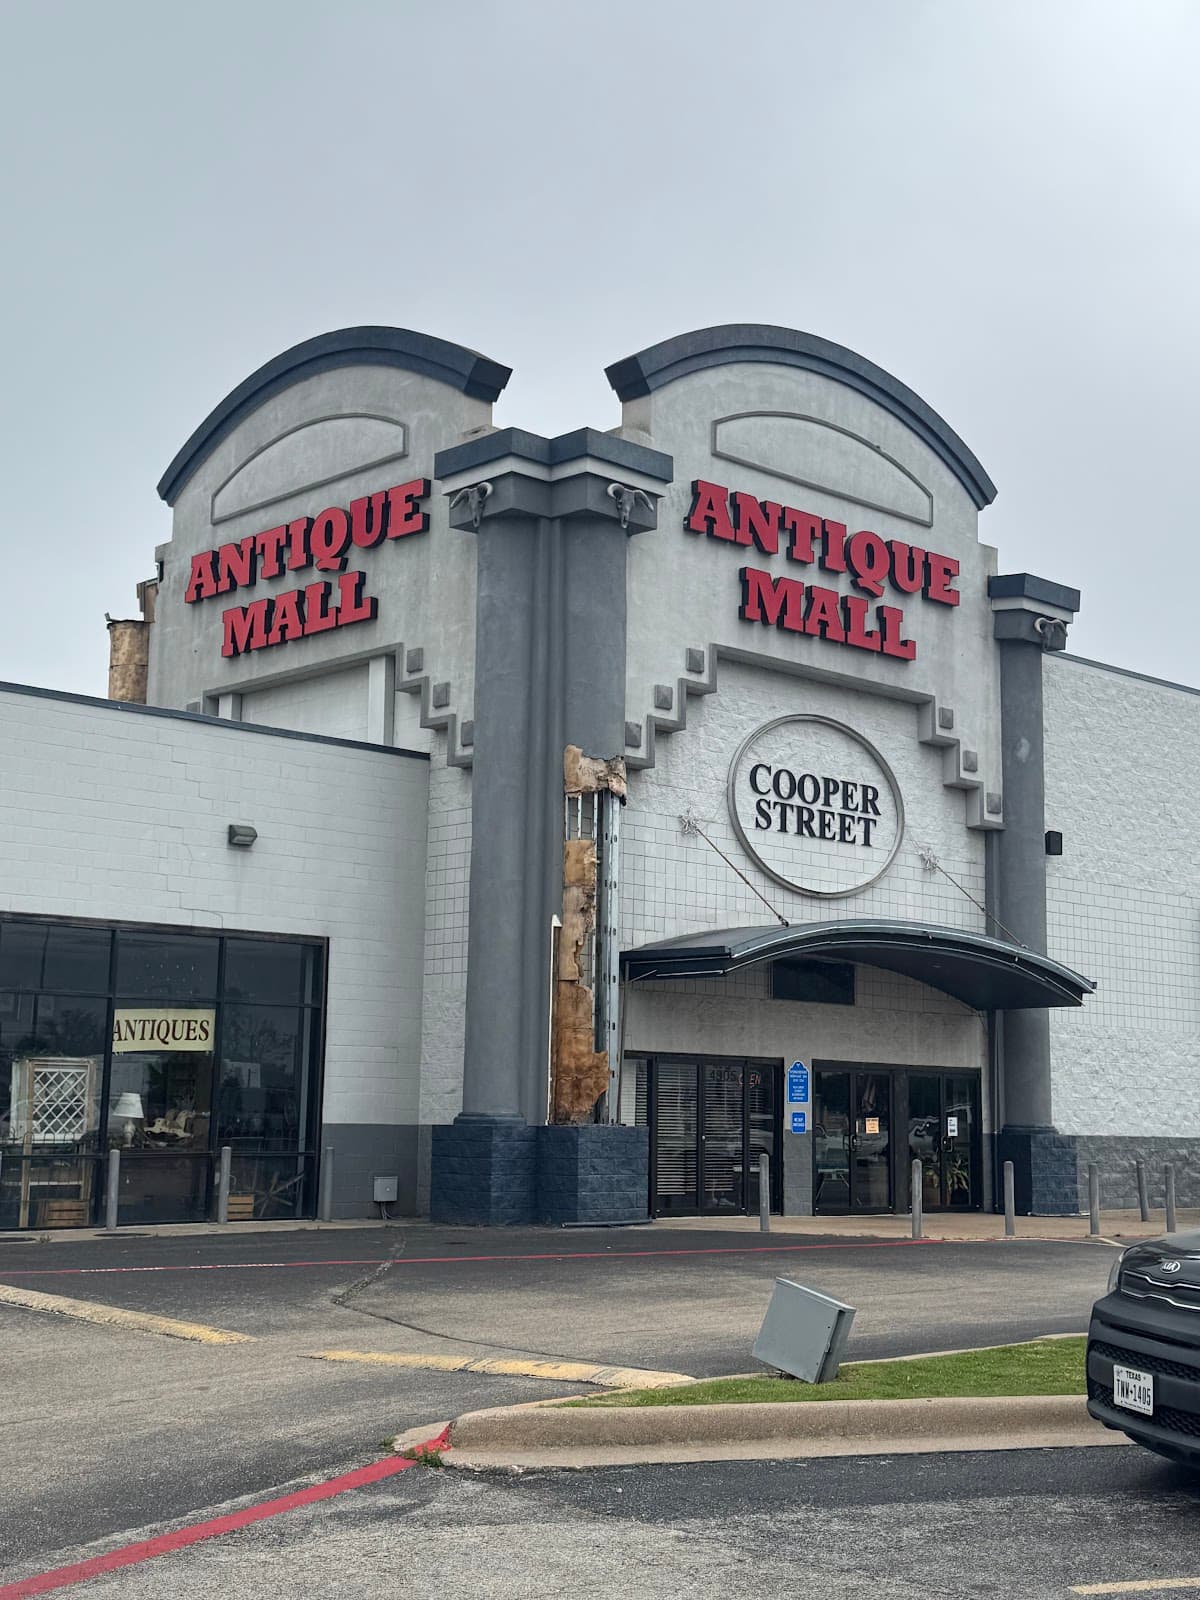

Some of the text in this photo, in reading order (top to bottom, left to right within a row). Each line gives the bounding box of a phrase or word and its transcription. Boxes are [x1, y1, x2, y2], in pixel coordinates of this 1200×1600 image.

[185, 478, 431, 604] ANTIQUE
[683, 479, 960, 607] ANTIQUE
[221, 571, 378, 659] MALL
[739, 566, 916, 661] MALL
[749, 763, 882, 816] COOPER
[755, 798, 877, 847] STREET
[111, 1019, 210, 1045] ANTIQUES
[1126, 1370, 1142, 1382] TEXAS
